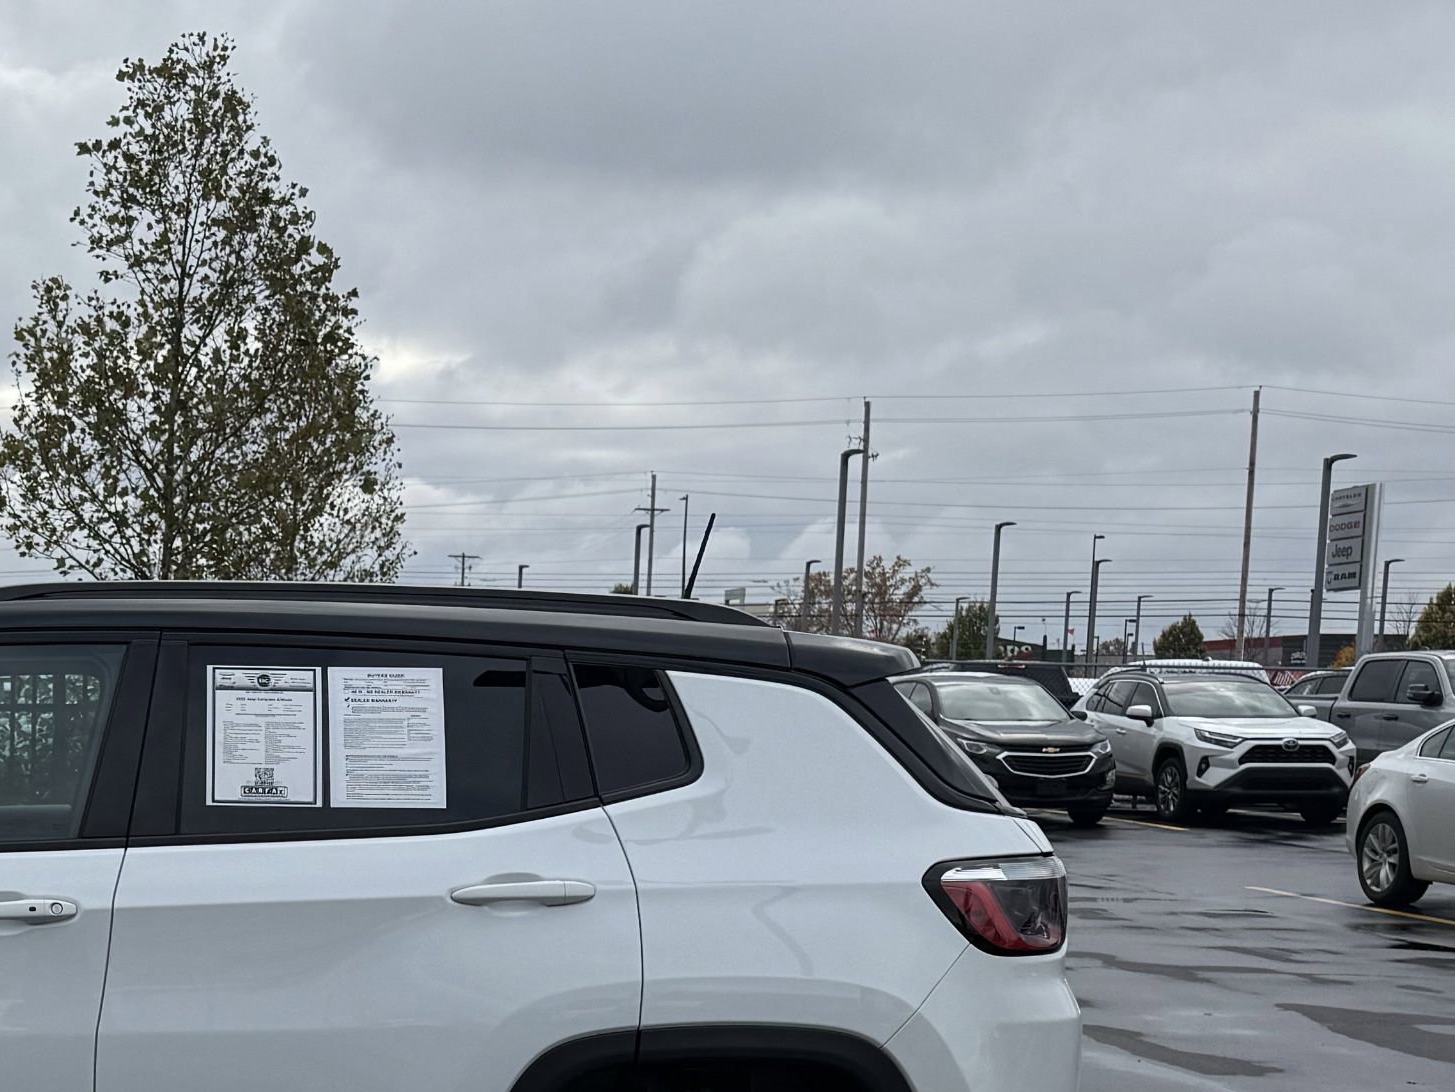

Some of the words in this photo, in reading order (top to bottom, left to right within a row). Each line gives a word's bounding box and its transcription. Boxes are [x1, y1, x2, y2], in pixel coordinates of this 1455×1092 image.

[1329, 520, 1361, 533] DODGE
[1331, 543, 1353, 560] Jeep
[1333, 571, 1357, 581] RAM
[244, 786, 285, 795] CARFAX
